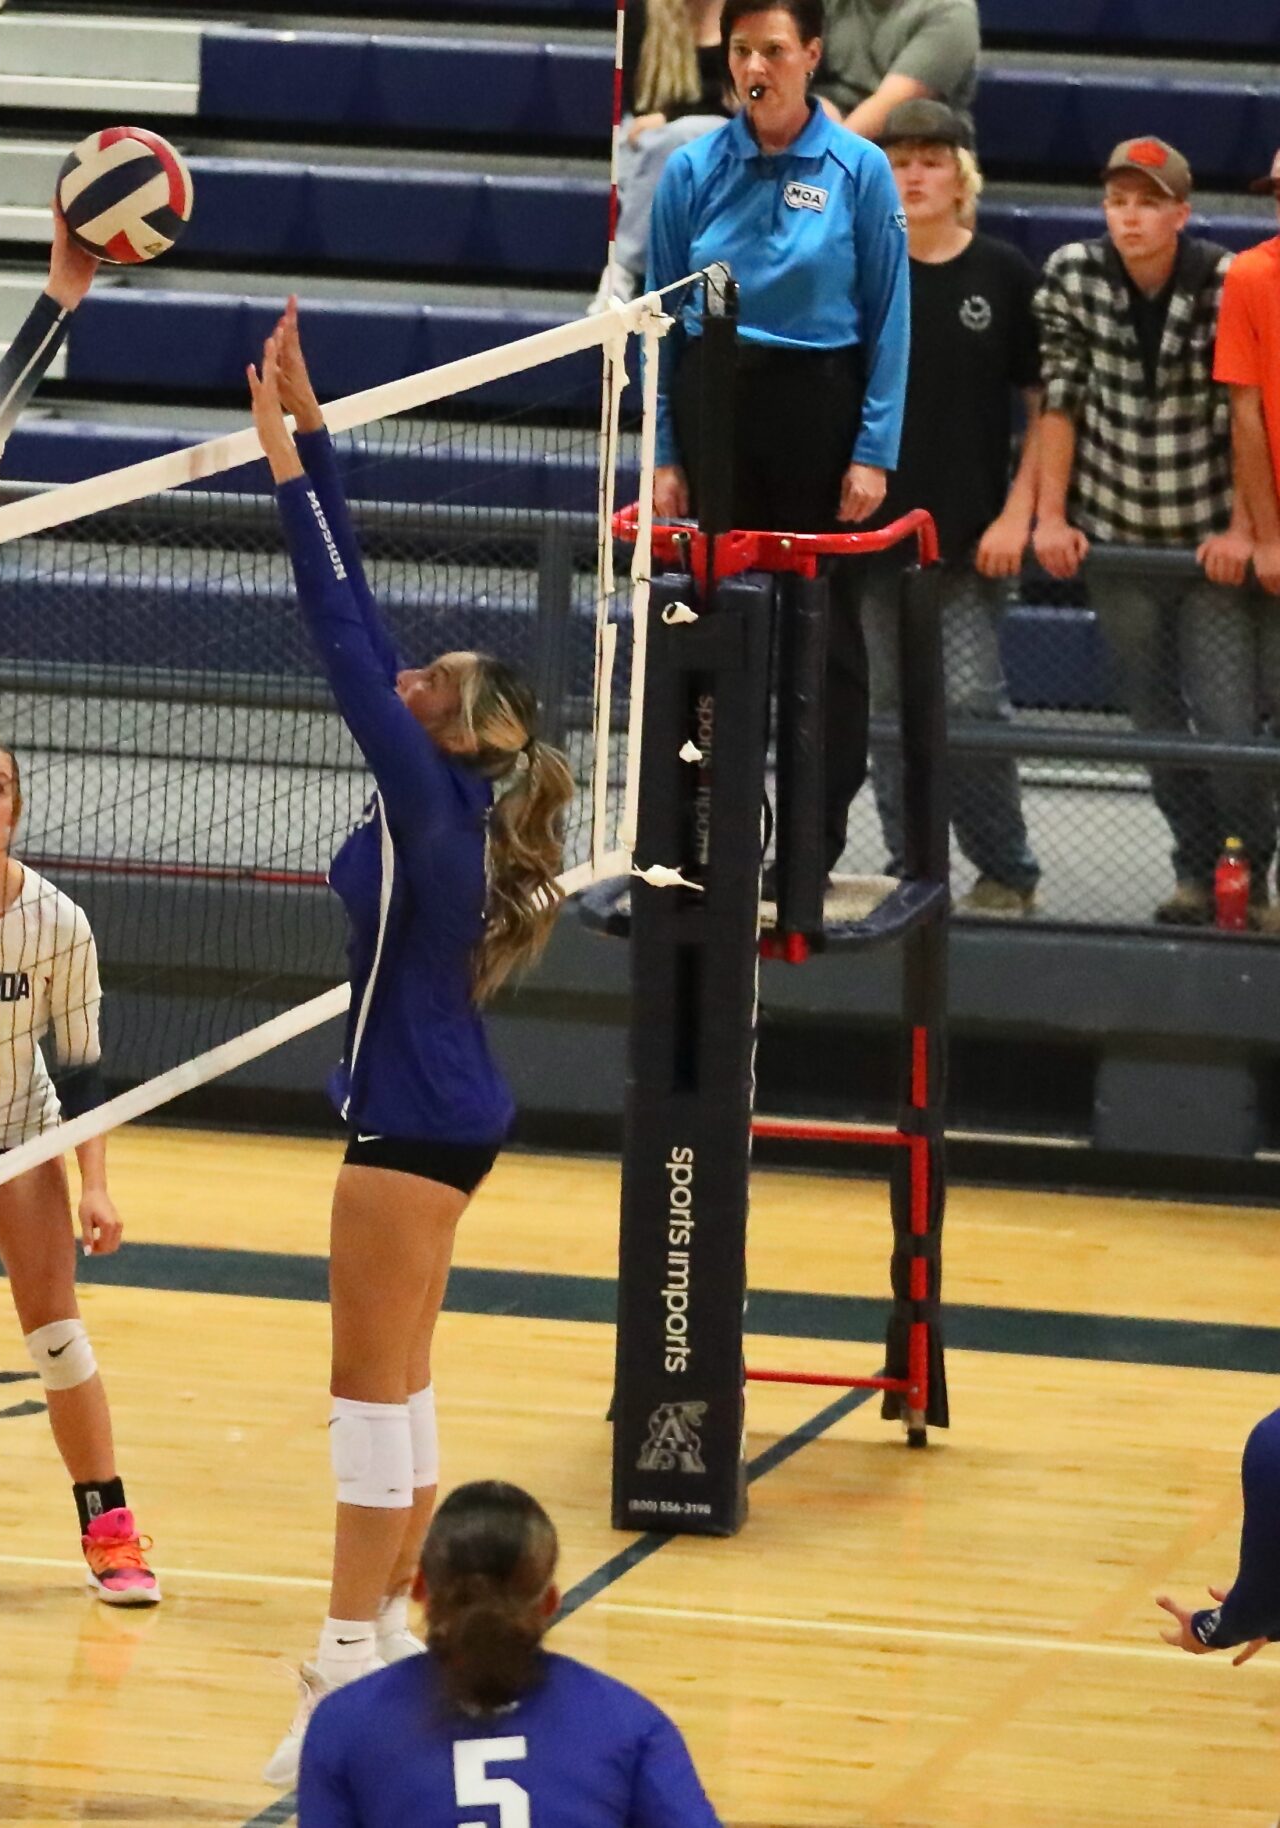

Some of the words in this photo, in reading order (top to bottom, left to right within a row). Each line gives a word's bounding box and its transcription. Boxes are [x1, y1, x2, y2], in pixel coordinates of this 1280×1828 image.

[790, 187, 821, 204] MOA
[305, 489, 348, 580] MISSION
[665, 1146, 695, 1245] sports
[453, 1735, 531, 1828] 5
